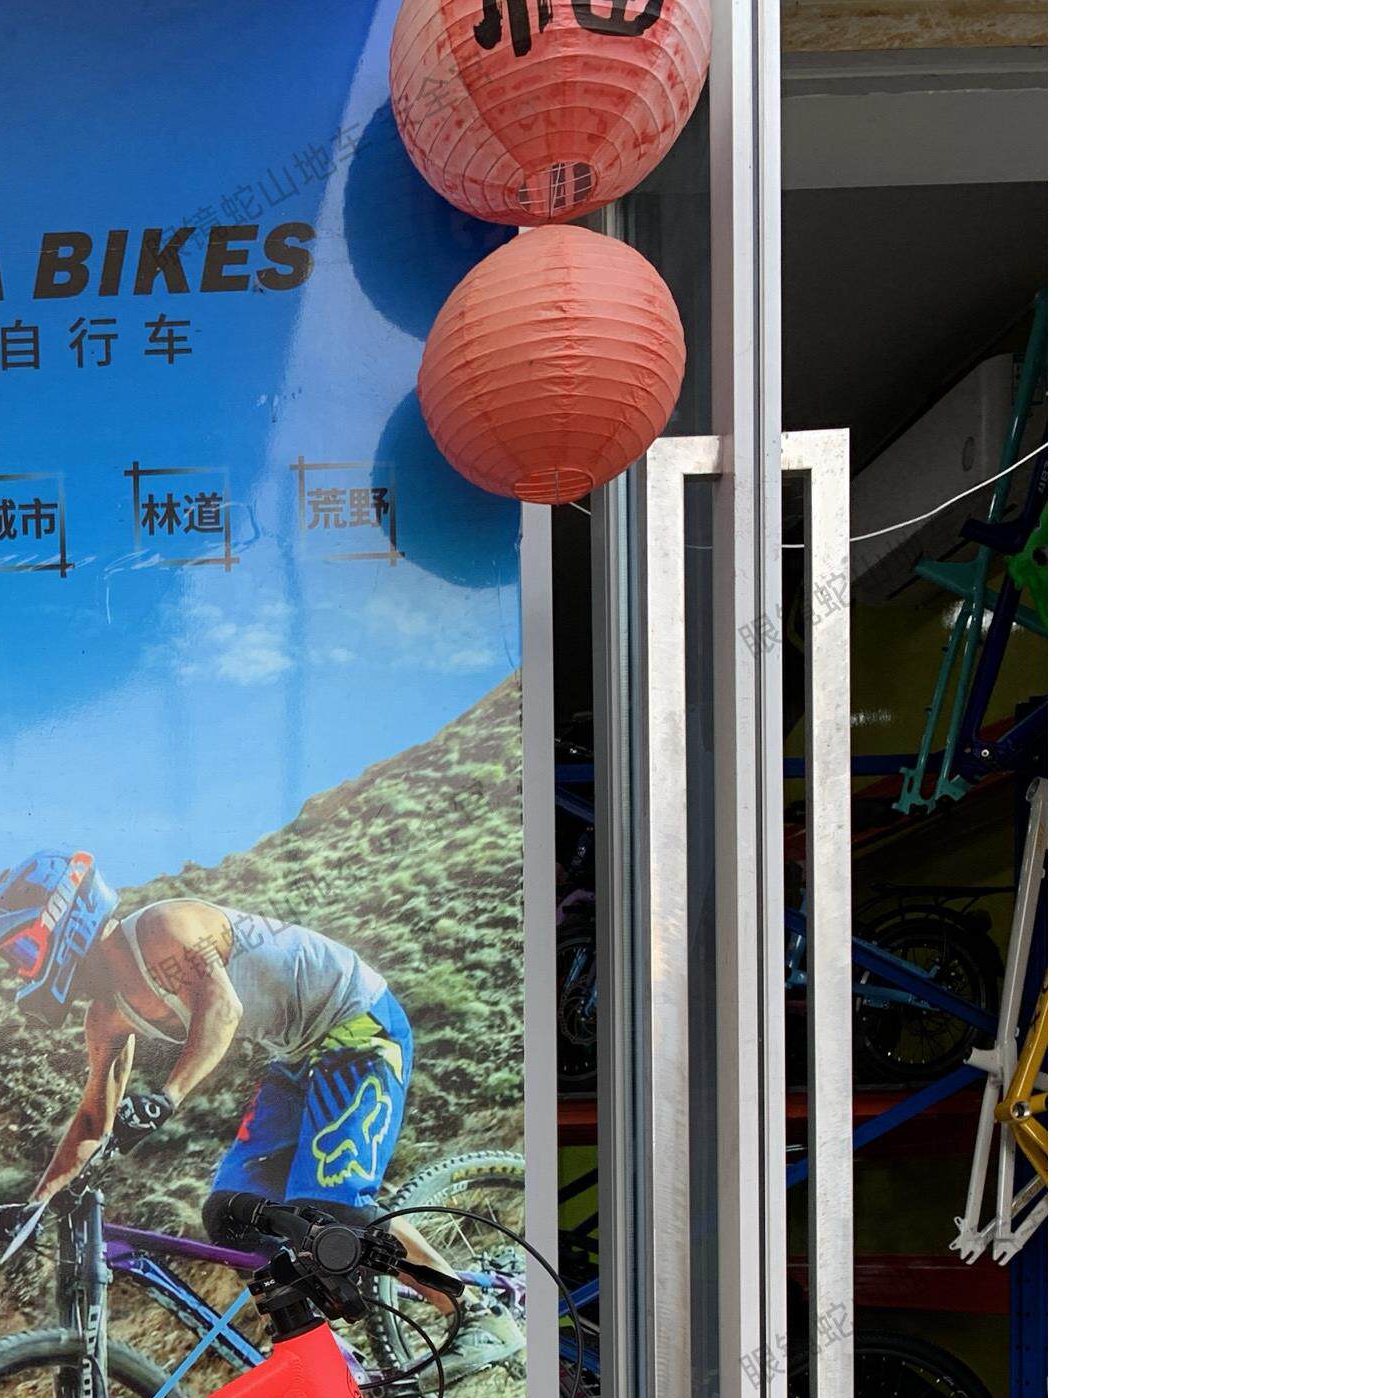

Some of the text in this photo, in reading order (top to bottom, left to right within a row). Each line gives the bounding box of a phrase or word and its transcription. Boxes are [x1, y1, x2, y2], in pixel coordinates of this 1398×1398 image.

[32, 221, 316, 300] BIKES
[141, 491, 225, 537] 林道
[306, 487, 390, 530] 荒野
